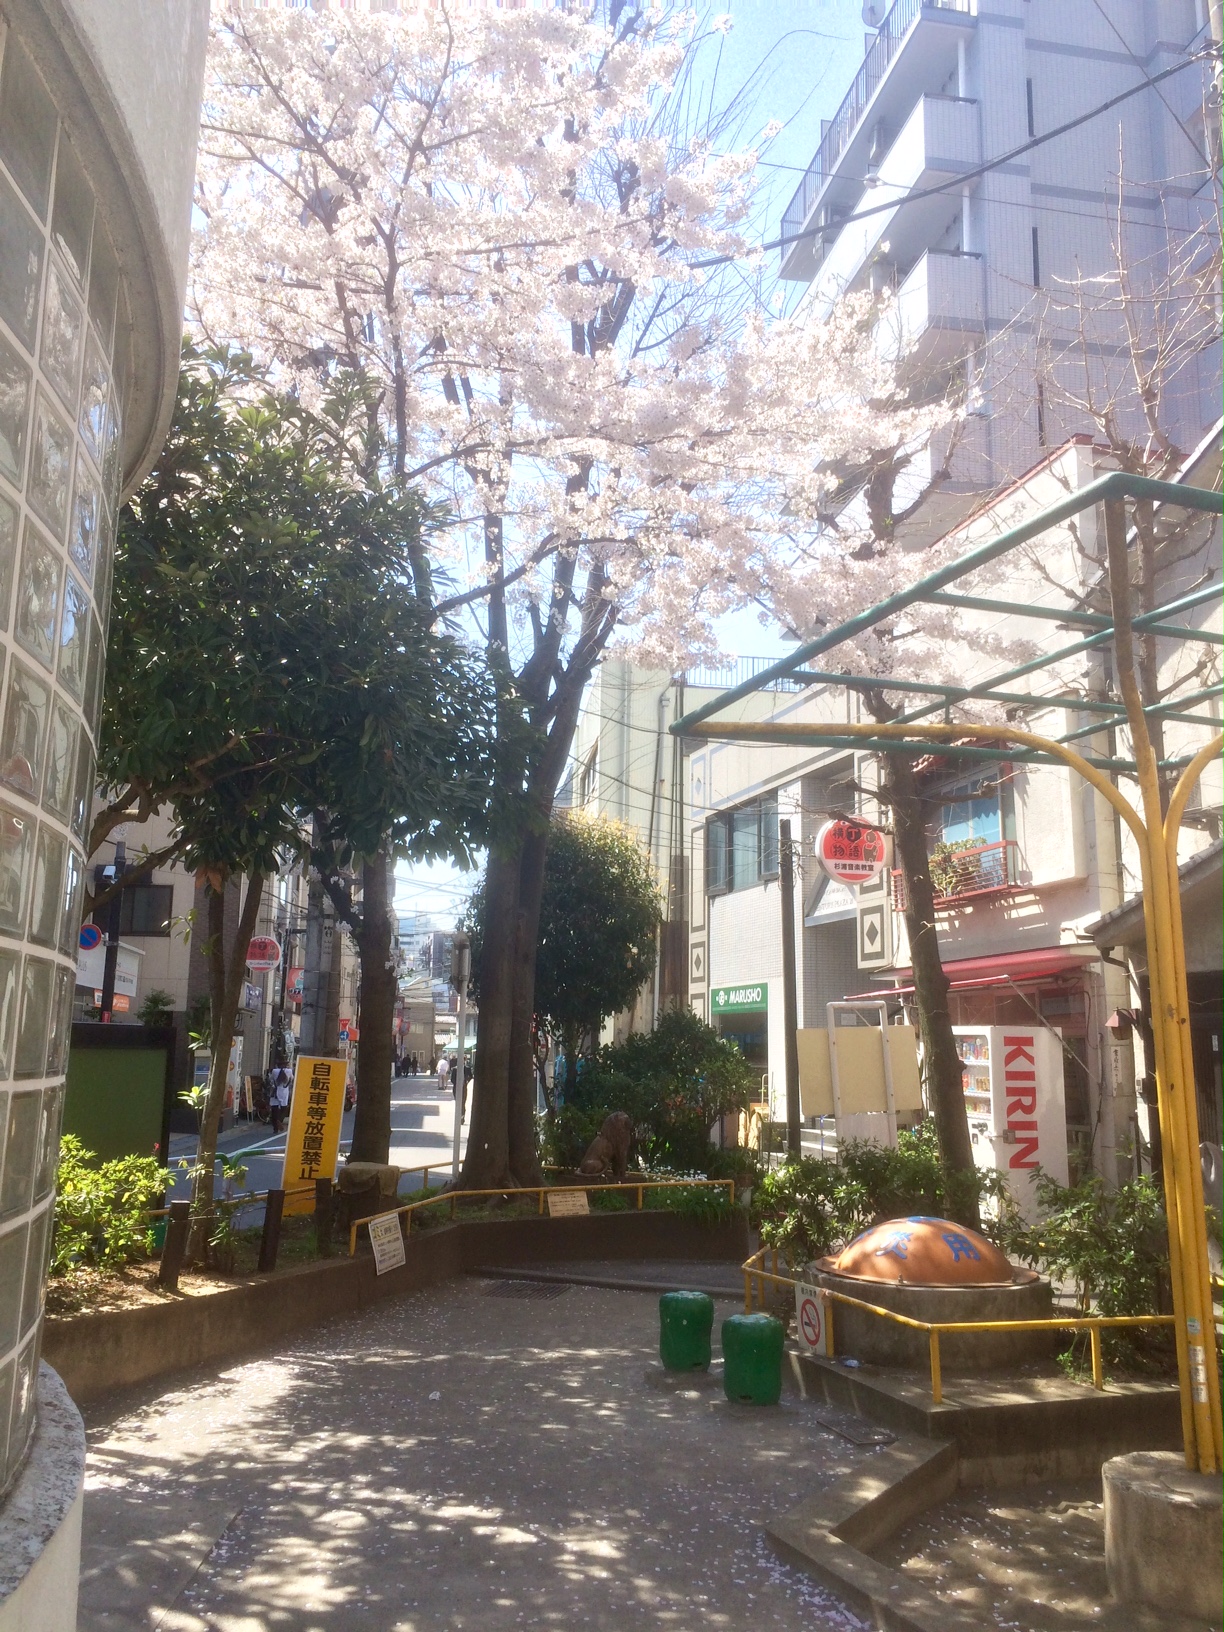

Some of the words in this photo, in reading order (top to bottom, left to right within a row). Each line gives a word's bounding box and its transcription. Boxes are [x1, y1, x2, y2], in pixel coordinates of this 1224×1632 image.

[729, 987, 762, 1004] MARUSHO
[299, 1062, 332, 1181] 自転車等放置禁止
[1003, 1036, 1040, 1169] KIRIN
